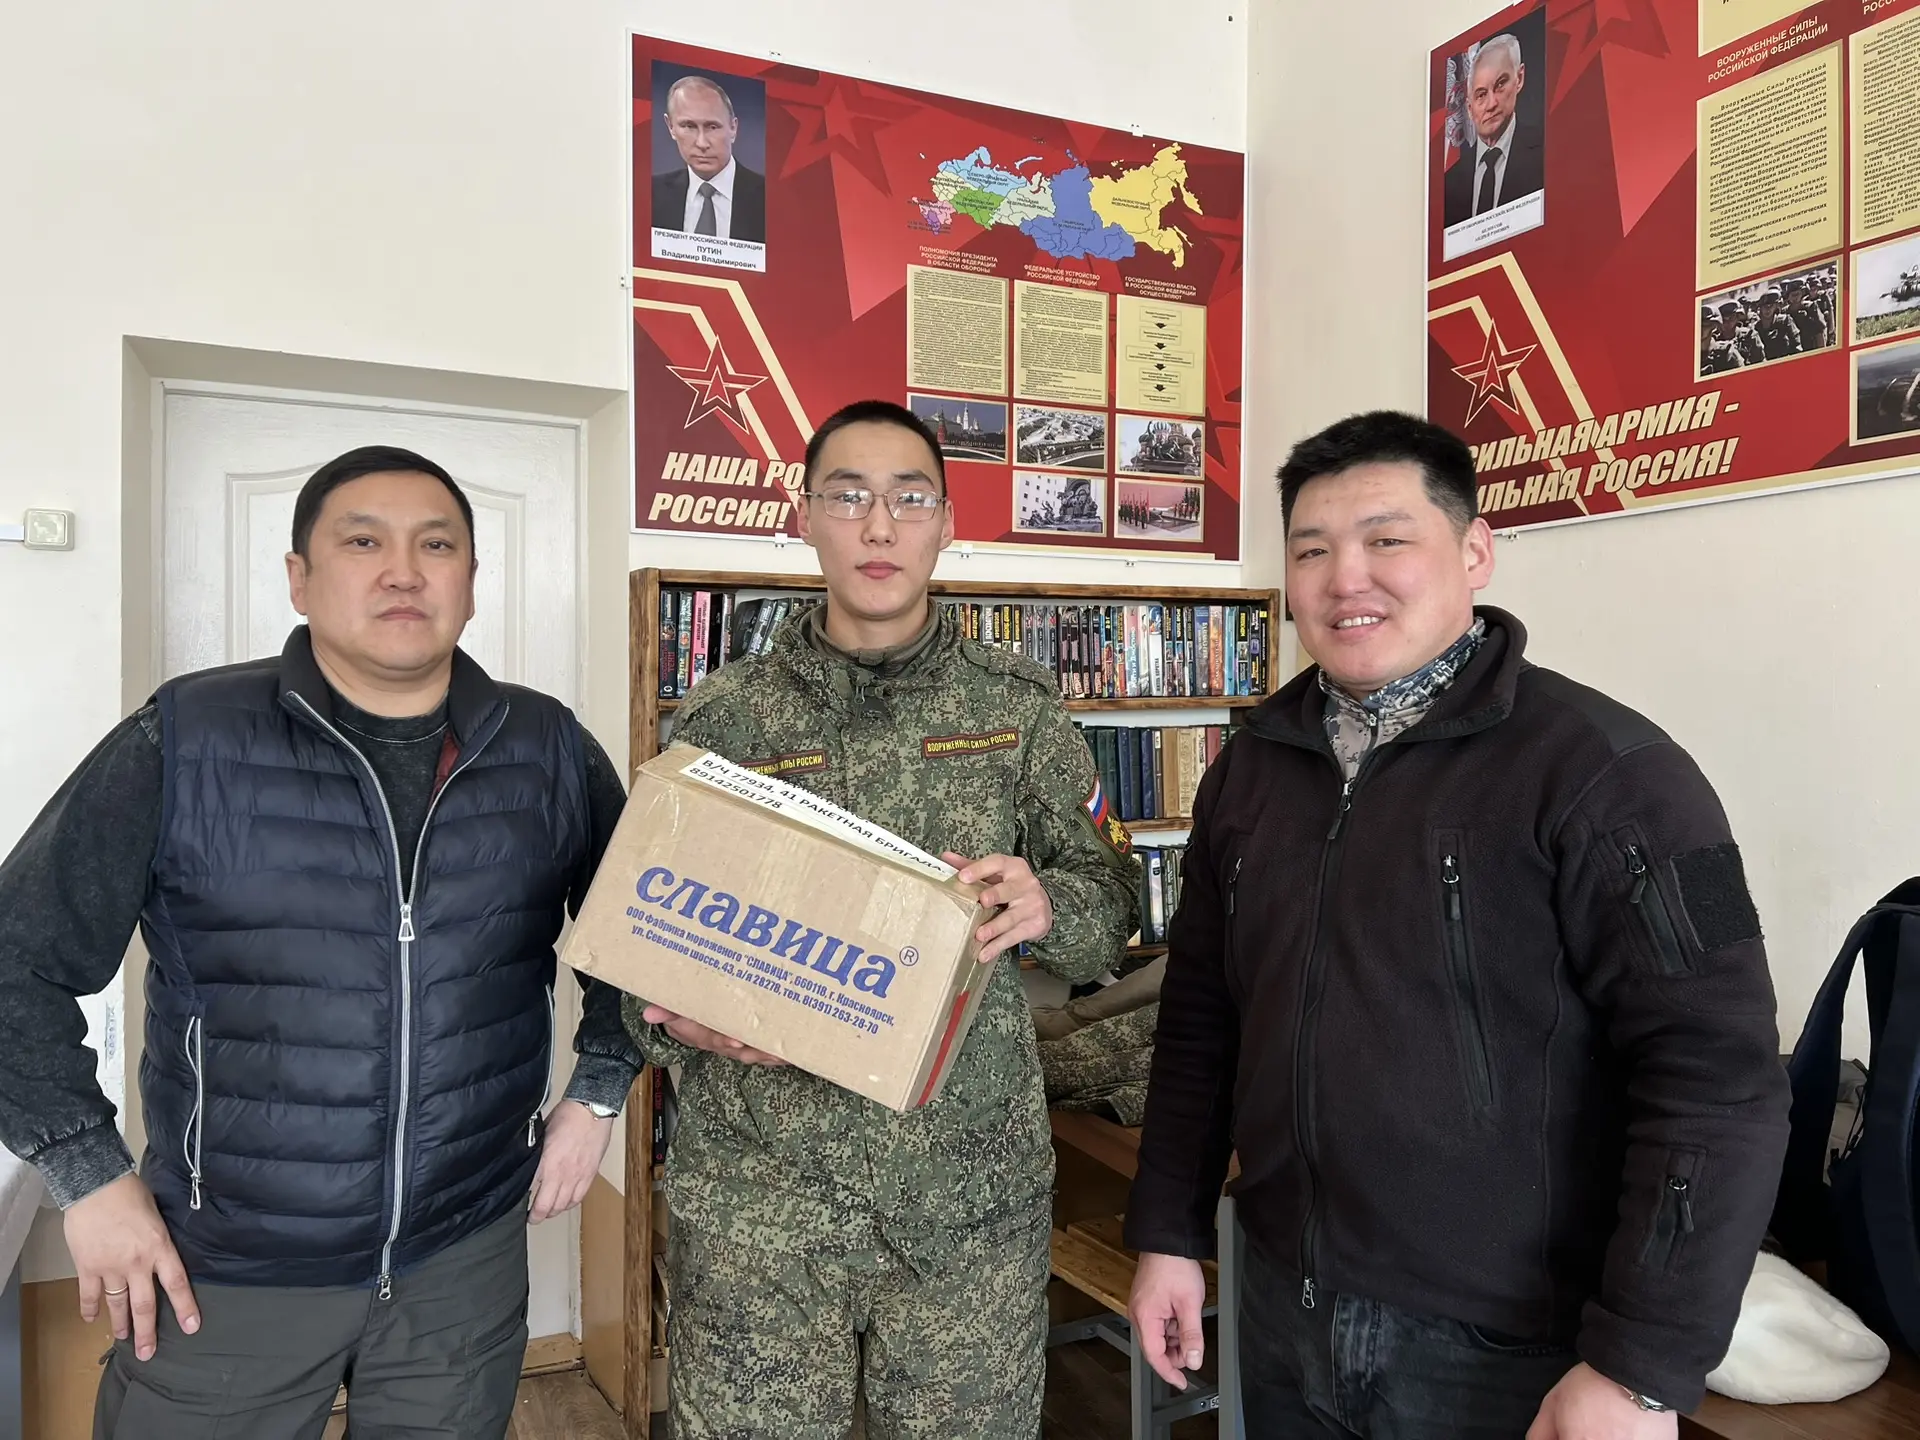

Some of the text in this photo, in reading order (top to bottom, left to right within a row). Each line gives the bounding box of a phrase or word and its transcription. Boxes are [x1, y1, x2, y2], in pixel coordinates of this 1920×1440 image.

[1717, 15, 1817, 68] ВООРУЖЕННЫЕ СИЛЫ
[1708, 22, 1827, 83] РОССИЙСКОЙ ФЕДЕРАЦИИ
[1720, 62, 1826, 111] Вооруженные Силы Российской
[1746, 111, 1758, 120] для
[1801, 83, 1826, 98] защиты
[1758, 125, 1774, 136] задач
[1785, 111, 1826, 132] договорами
[1739, 172, 1756, 183] перед
[1803, 145, 1826, 159] Силами
[1743, 170, 1776, 188] Федерации
[1710, 196, 1725, 206] могут
[1751, 201, 1768, 212] угроз
[1814, 181, 1826, 189] или
[1790, 187, 1826, 204] Российской
[654, 230, 762, 252] ПРЕЗИДЕНТ РОССИЙСКОЙ ФЕДЕРАЦИИ
[696, 245, 721, 255] ПУТИН
[661, 248, 756, 270] Владимир Владимирович
[919, 245, 997, 262] ПОЛНОМОЧИЯ ПРЕЗИДЕНТА
[921, 251, 996, 269] РОССИЙСКОЙ ФЕДЕРАЦИИ
[932, 259, 959, 268] ОБЛАСТИ
[960, 264, 990, 273] ОБОРОНЫ
[1024, 264, 1100, 280] ФЕДЕРАЛЬНОЕ УСТРОЙСТВО
[1027, 270, 1097, 286] РОССИЙСКОЙ ФЕДЕРАЦИИ
[1125, 276, 1175, 288] ГОСУДАРСТВЕННУЮ
[1130, 282, 1165, 291] РОССИЙСКОЙ
[1165, 288, 1196, 296] ФЕДЕРАЦИИ
[1139, 289, 1181, 299] ОСУЩЕСТВЛЯЮТ
[1594, 391, 1722, 449] АРМИЯ
[661, 451, 759, 487] НАША
[1584, 437, 1739, 496] РОССИЯ!
[648, 492, 791, 529] РОССИЯ!
[970, 738, 990, 749] СИЛЫ
[990, 732, 1016, 744] РОССИИ
[796, 754, 822, 767] РОССИИ
[689, 767, 784, 809] 89142501778
[702, 758, 729, 776] В/Ч
[730, 773, 775, 794] 77934,
[779, 788, 797, 802] 41
[799, 798, 872, 839] РАКЕТНАЯ
[627, 905, 643, 922] ООО
[645, 911, 684, 940] Фабрика
[685, 930, 741, 963] мороженого
[794, 973, 827, 999] 660118,
[828, 989, 835, 1001] г.
[836, 991, 894, 1028] Красноярск,
[632, 923, 877, 1036] ул. Северное шоссе, 43, а/я 28278, тел. 8(391) 263-28-70
